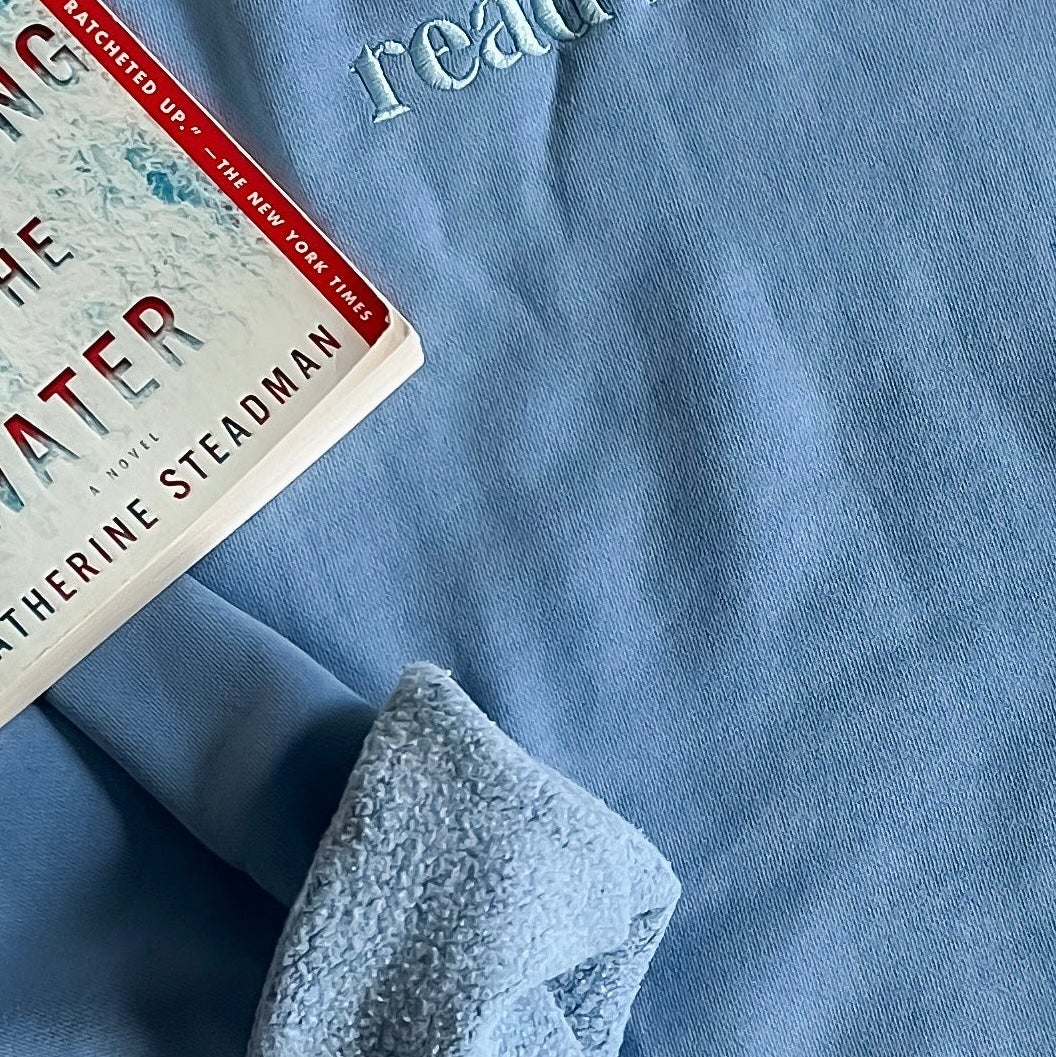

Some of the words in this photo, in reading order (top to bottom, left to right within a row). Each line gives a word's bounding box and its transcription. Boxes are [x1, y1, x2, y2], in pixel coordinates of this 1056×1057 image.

[246, 191, 285, 227] NEW
[285, 229, 329, 274] YORK
[329, 275, 373, 322] TIMES
[89, 485, 101, 496] A
[105, 432, 160, 480] NOVEL
[159, 324, 342, 500] STEADMAN
